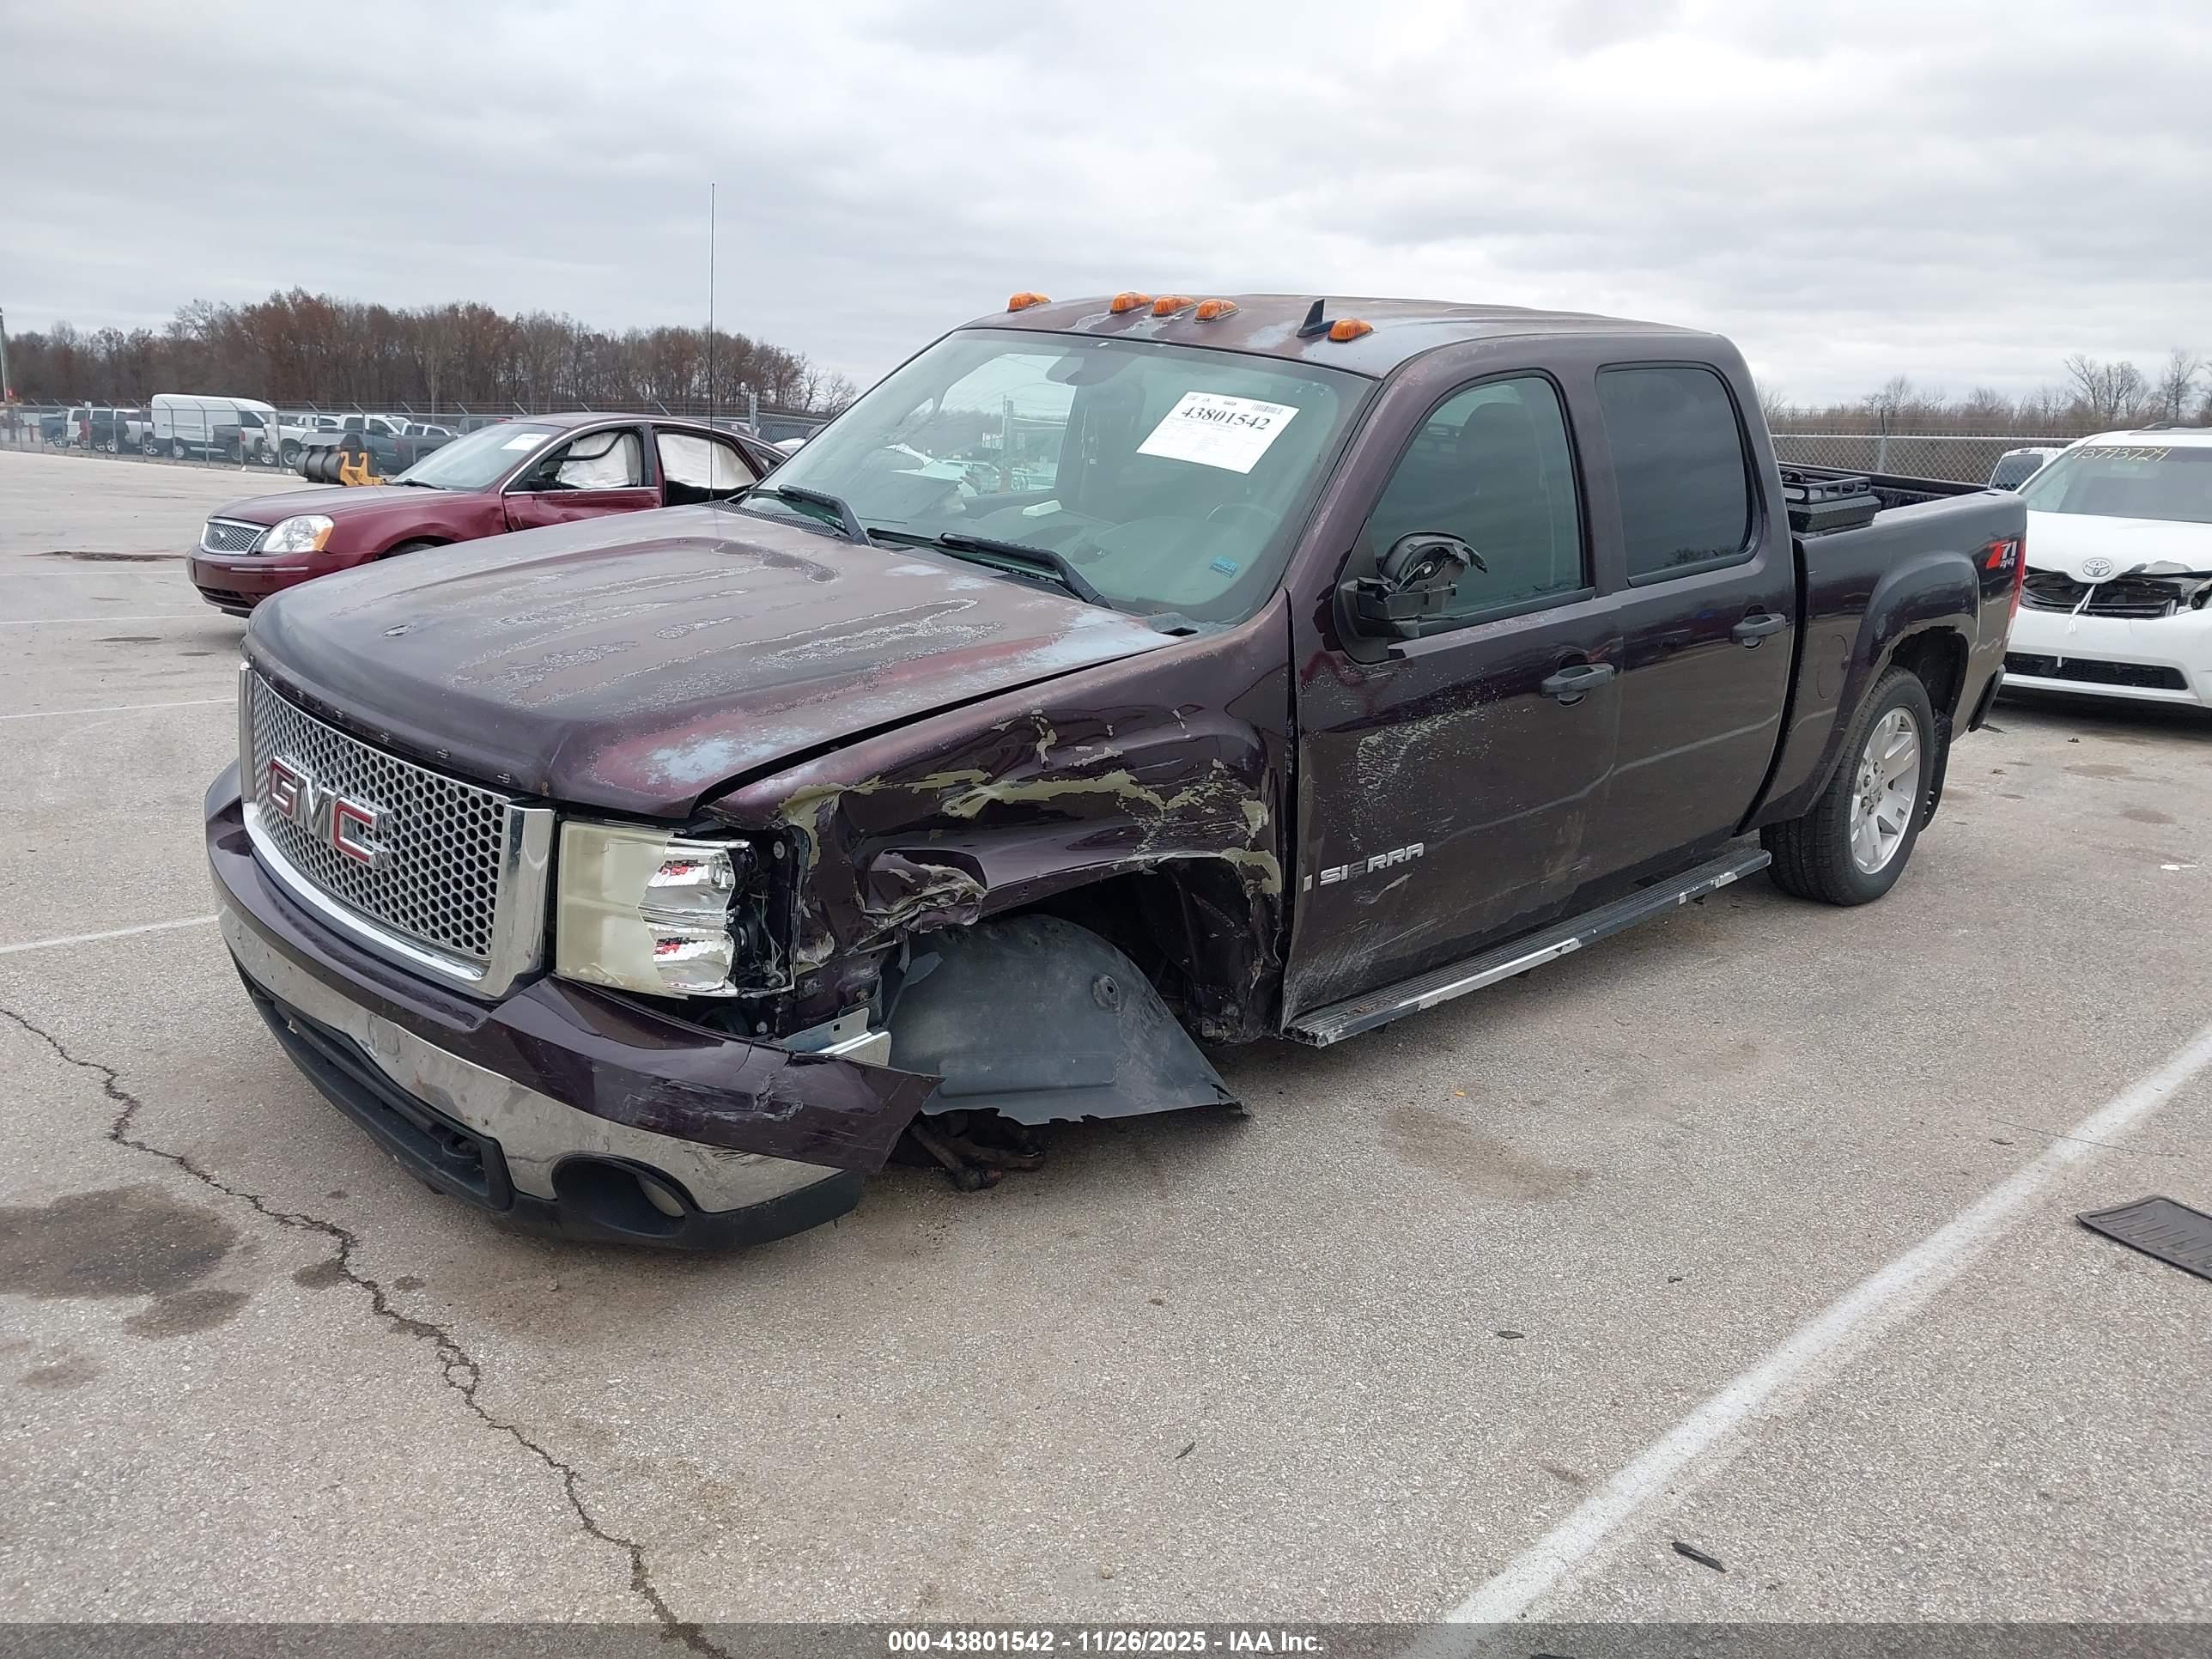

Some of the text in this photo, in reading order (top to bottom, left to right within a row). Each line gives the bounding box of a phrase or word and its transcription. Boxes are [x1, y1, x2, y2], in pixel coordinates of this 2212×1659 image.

[1182, 405, 1271, 430] 43801542
[2069, 447, 2172, 462] 43793724
[1985, 540, 2017, 570] Z71
[269, 756, 392, 869] GMC
